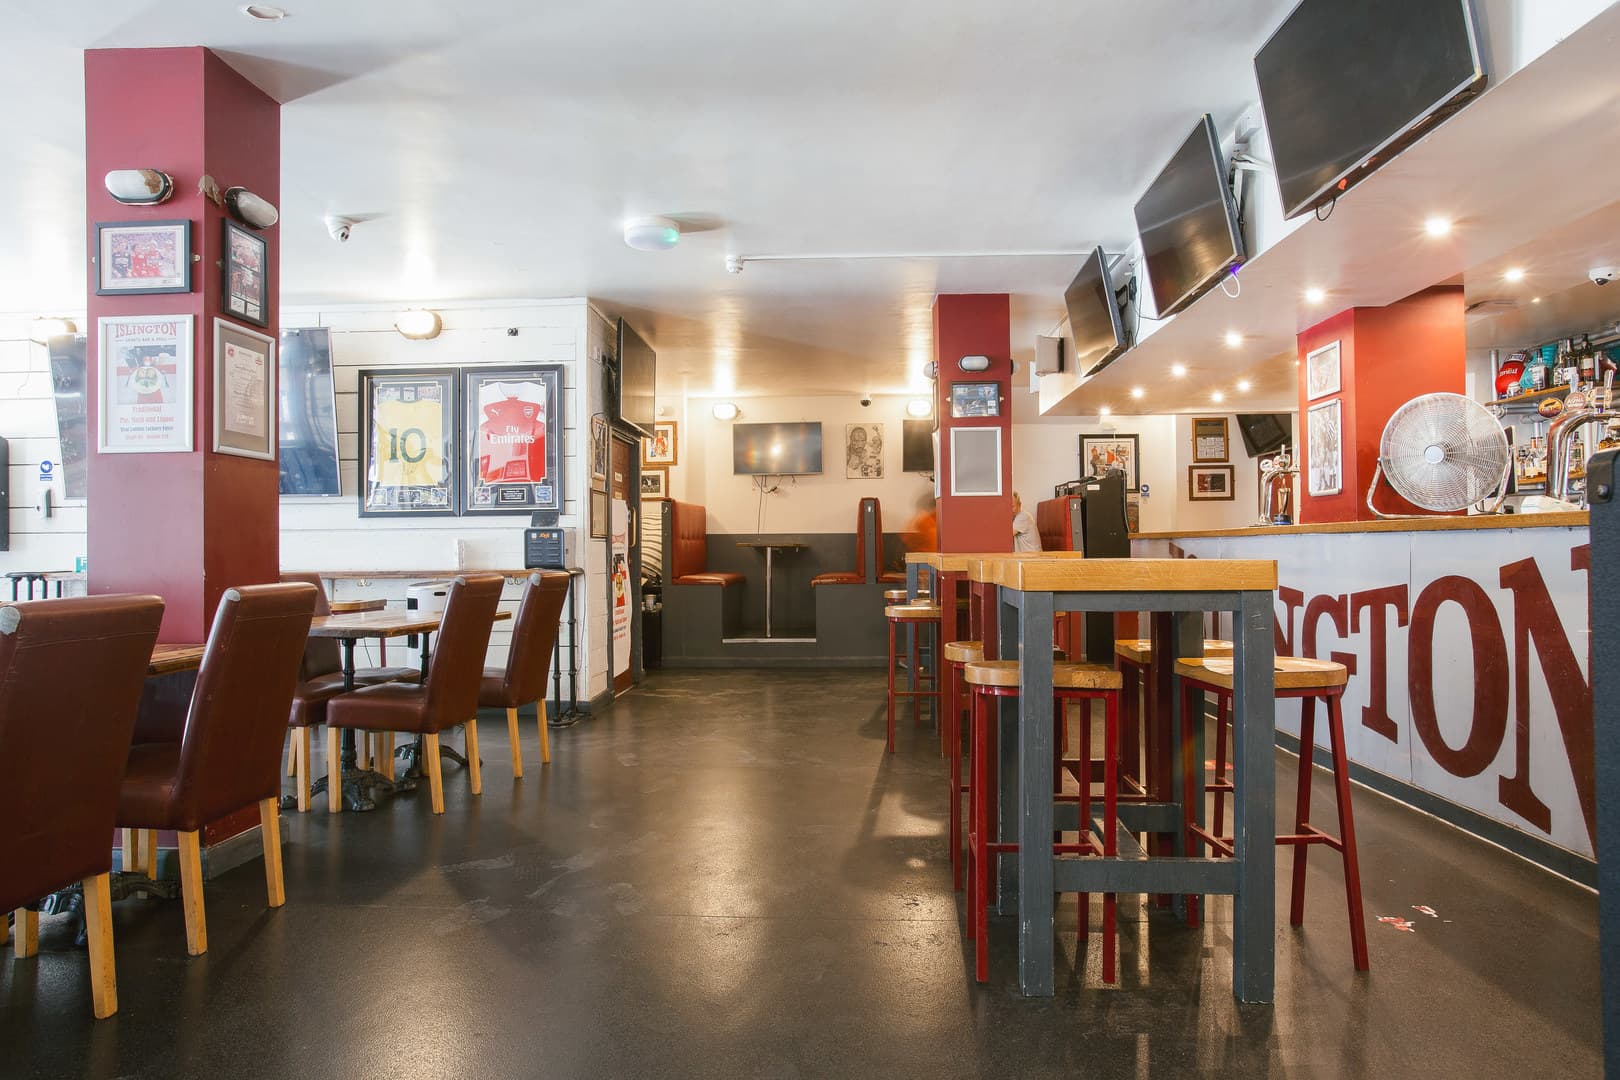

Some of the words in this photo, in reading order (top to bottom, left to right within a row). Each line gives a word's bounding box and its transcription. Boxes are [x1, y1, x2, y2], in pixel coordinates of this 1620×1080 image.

[115, 322, 176, 338] ISLINGTON
[505, 425, 519, 434] Fly
[389, 428, 426, 463] 10
[490, 434, 535, 444] Emirates
[1169, 542, 1598, 864] NGTON
